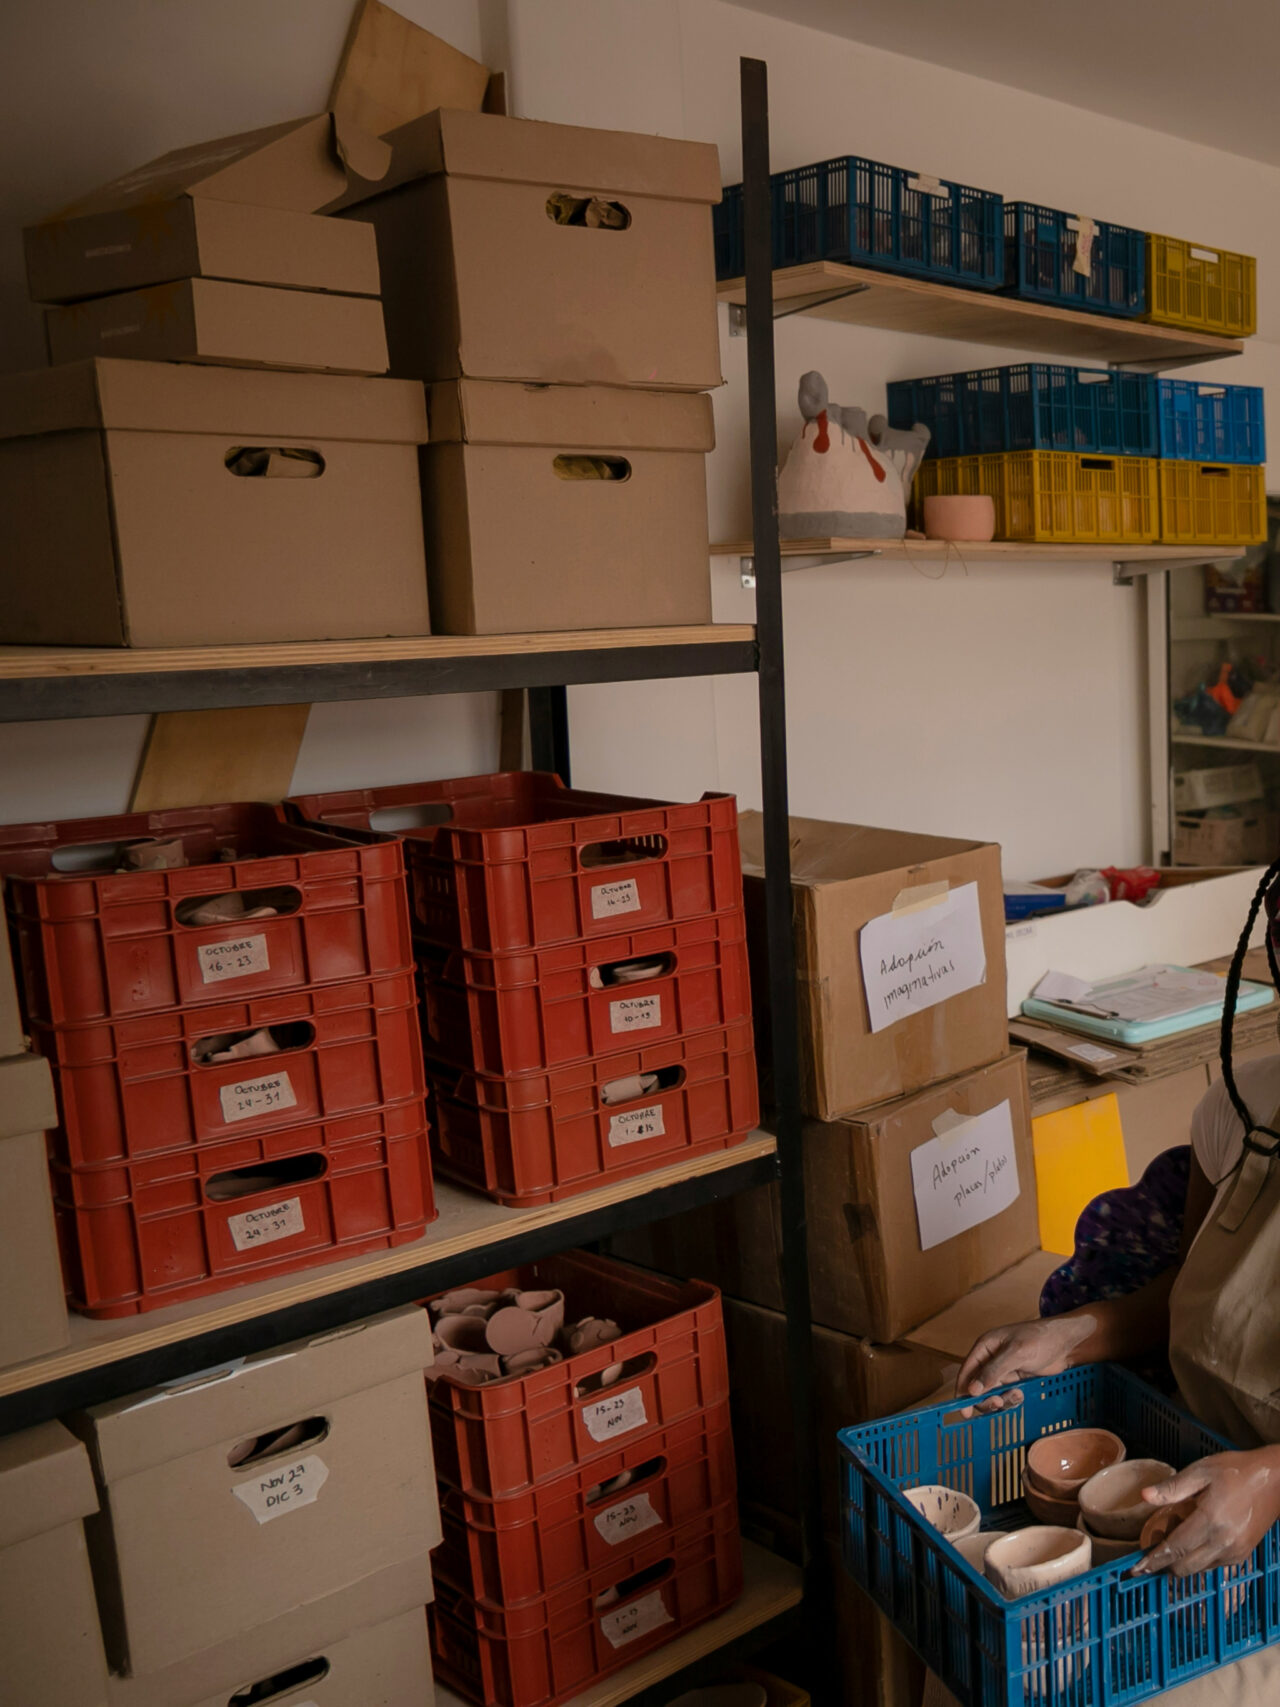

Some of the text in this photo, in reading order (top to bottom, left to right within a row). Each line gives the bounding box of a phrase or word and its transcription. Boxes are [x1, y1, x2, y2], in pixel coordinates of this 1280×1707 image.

[205, 941, 253, 956] OCTUBRE
[234, 1080, 281, 1095] OCTUBRE
[618, 1109, 656, 1124] OCTUBRE
[245, 1203, 290, 1222] OCTUBRE
[266, 1483, 303, 1507] DIC 3
